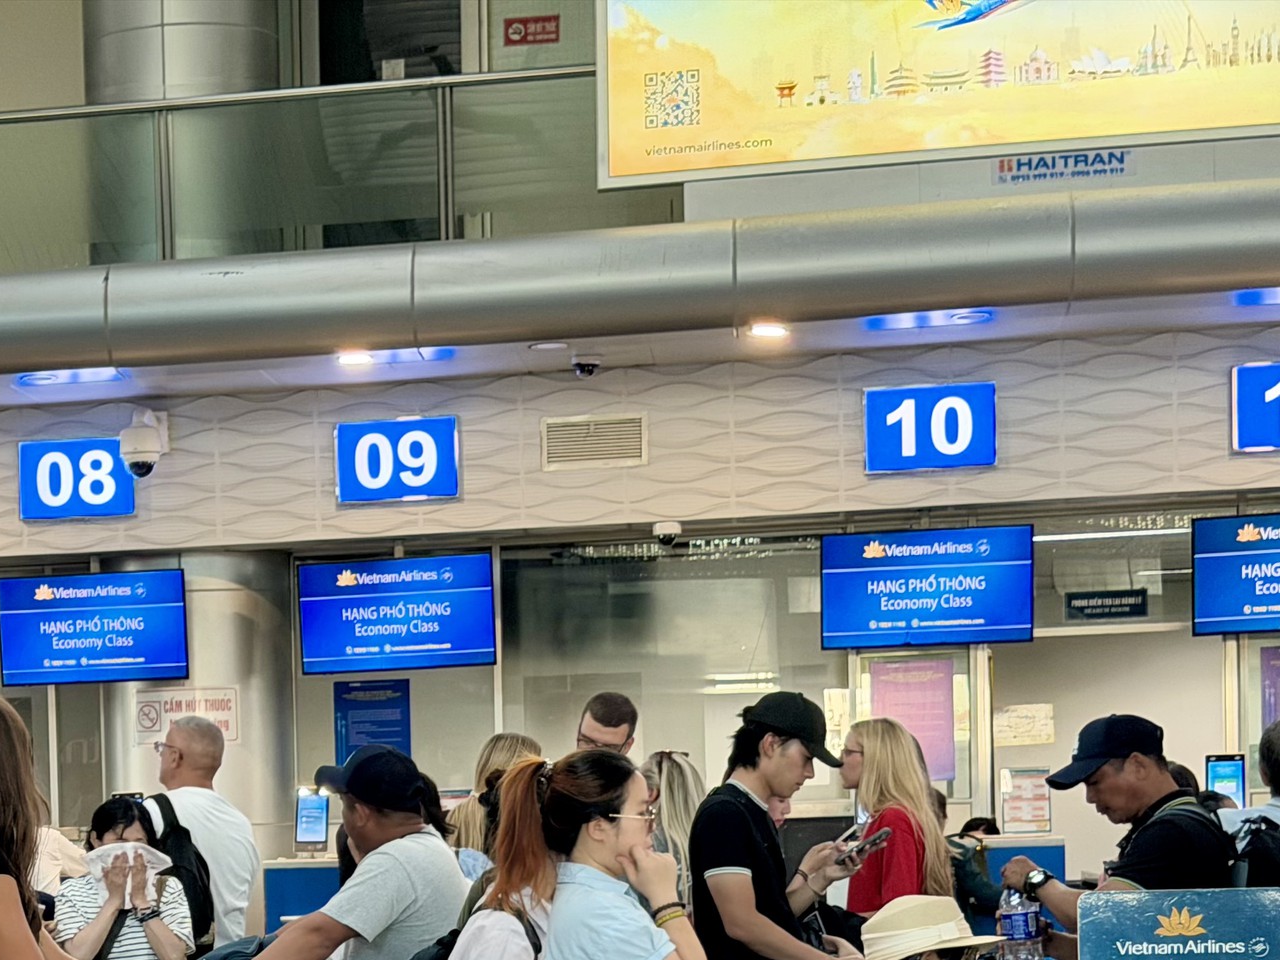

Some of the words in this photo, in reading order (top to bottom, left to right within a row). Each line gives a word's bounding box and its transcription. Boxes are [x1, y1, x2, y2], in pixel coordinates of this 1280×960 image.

[645, 138, 773, 156] vietnamairlines.com
[886, 396, 974, 457] 10
[354, 430, 438, 490] 09
[36, 449, 117, 507] 08
[868, 578, 905, 597] HẠNG
[938, 574, 986, 592] THÔNG
[342, 606, 377, 623] HẠNG
[407, 601, 451, 618] THÔNG
[880, 596, 939, 612] Economy
[941, 594, 973, 608] Class
[40, 620, 74, 636] HẠNG
[102, 616, 144, 631] THÔNG
[355, 622, 408, 637] Economy
[410, 619, 439, 633] Class
[52, 636, 103, 651] Economy
[105, 633, 134, 647] Class
[163, 697, 183, 714] CẤM
